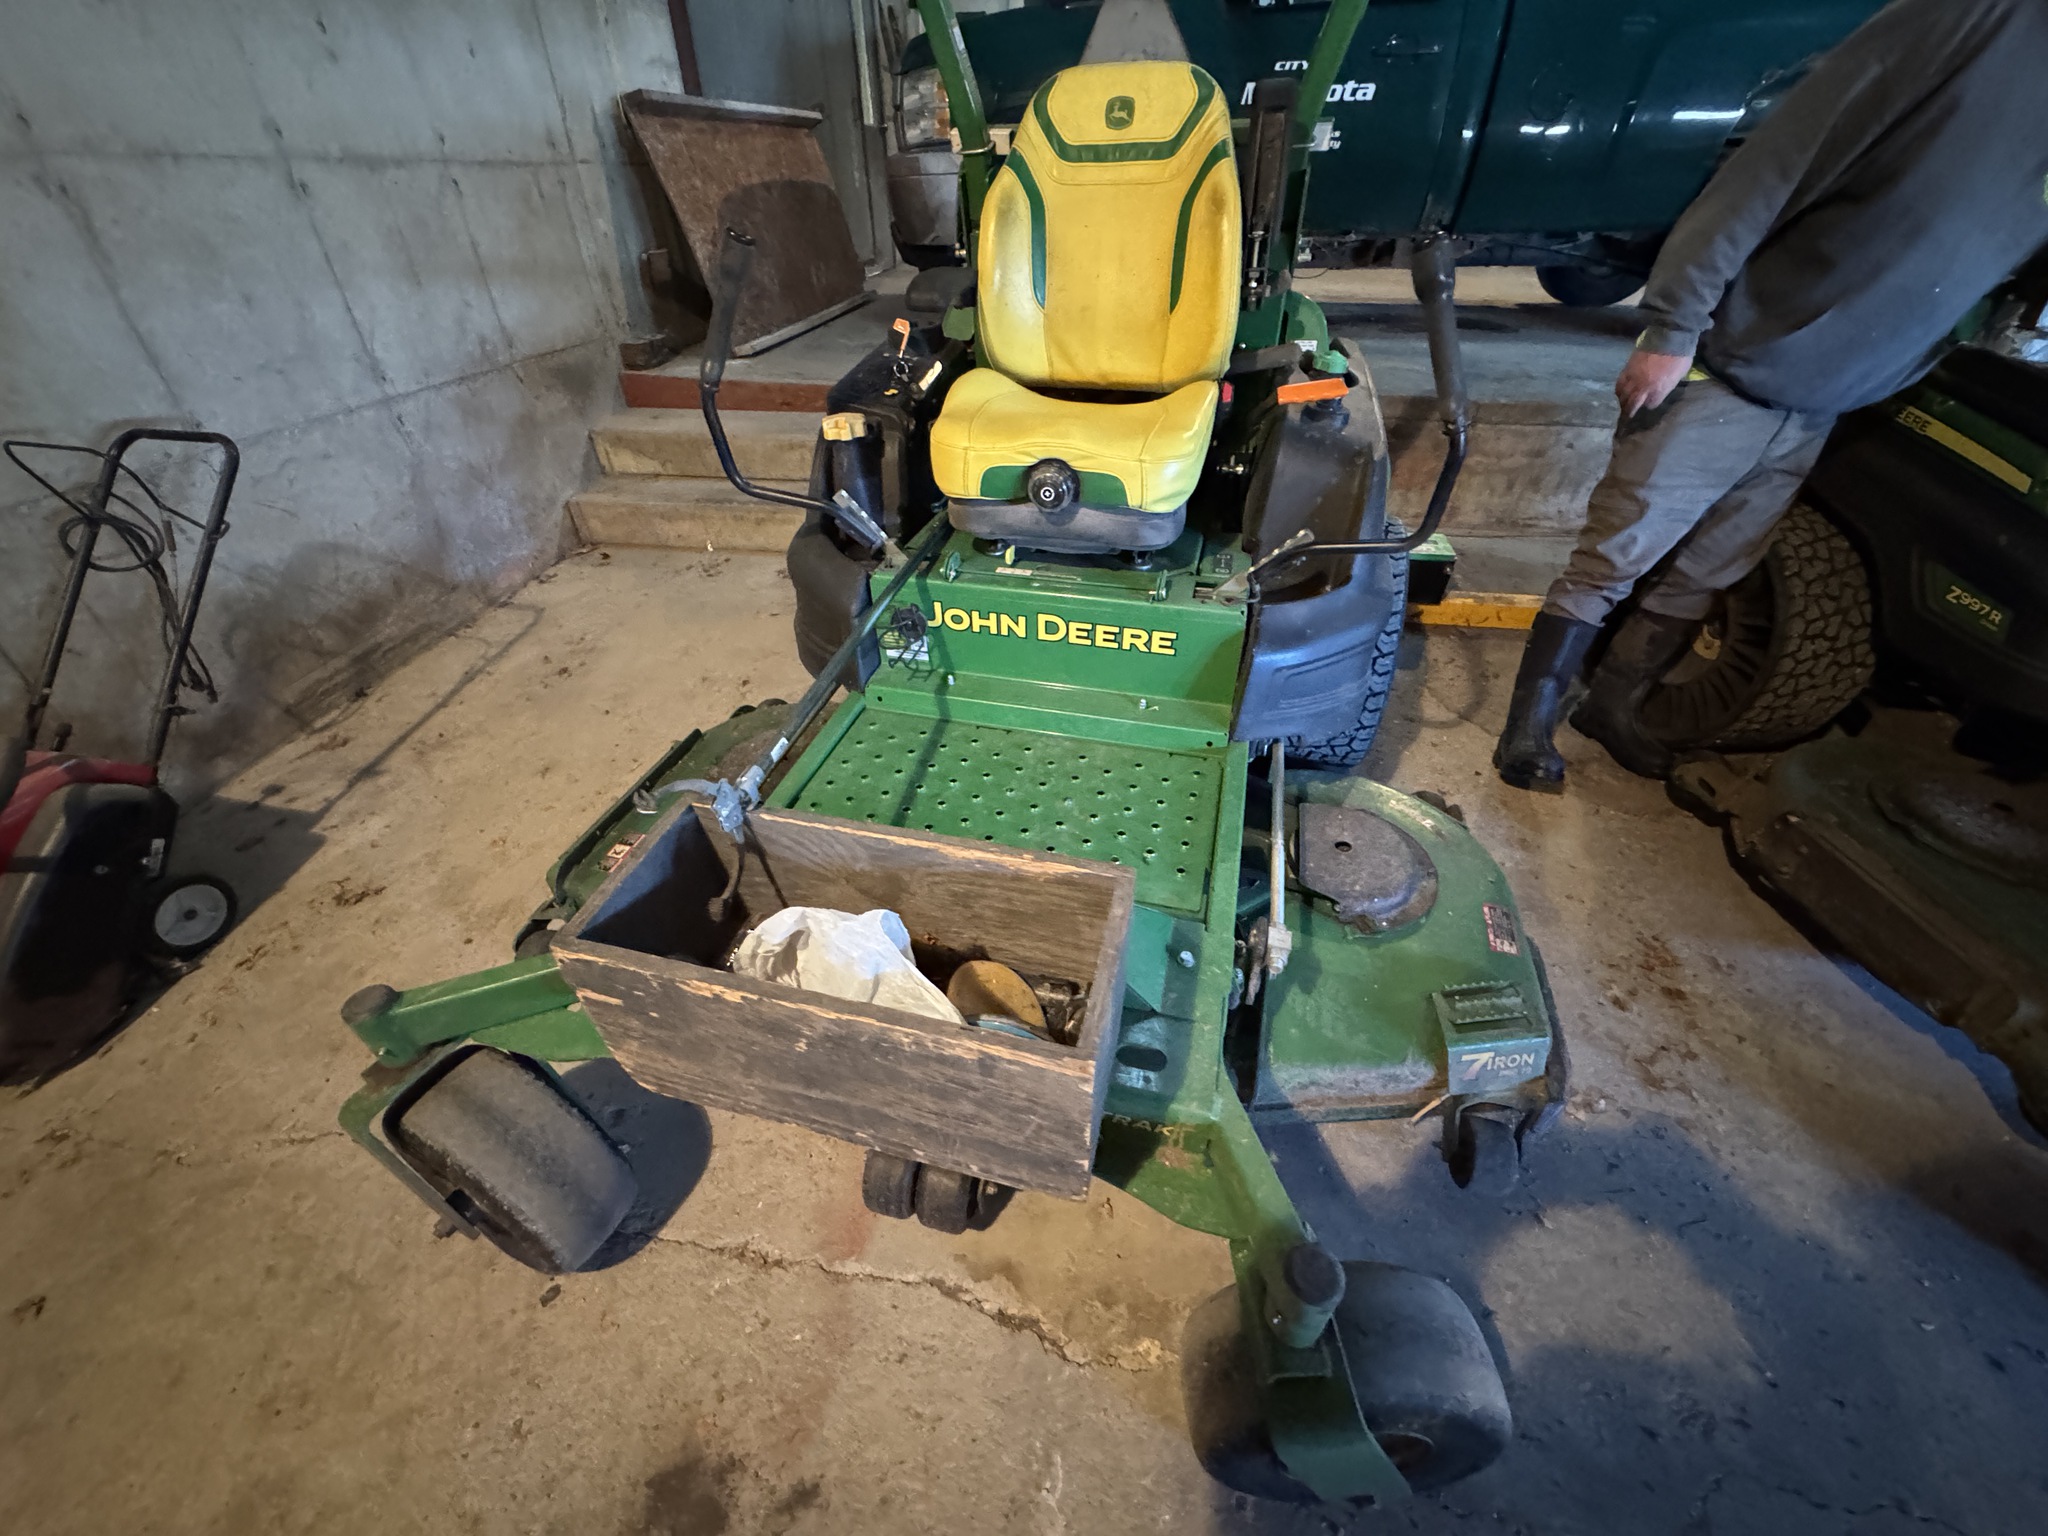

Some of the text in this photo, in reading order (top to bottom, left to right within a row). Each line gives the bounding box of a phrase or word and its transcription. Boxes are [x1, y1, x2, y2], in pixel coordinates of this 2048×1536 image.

[927, 601, 1178, 656] JOHN DEERE
[1945, 585, 2003, 625] Z997R
